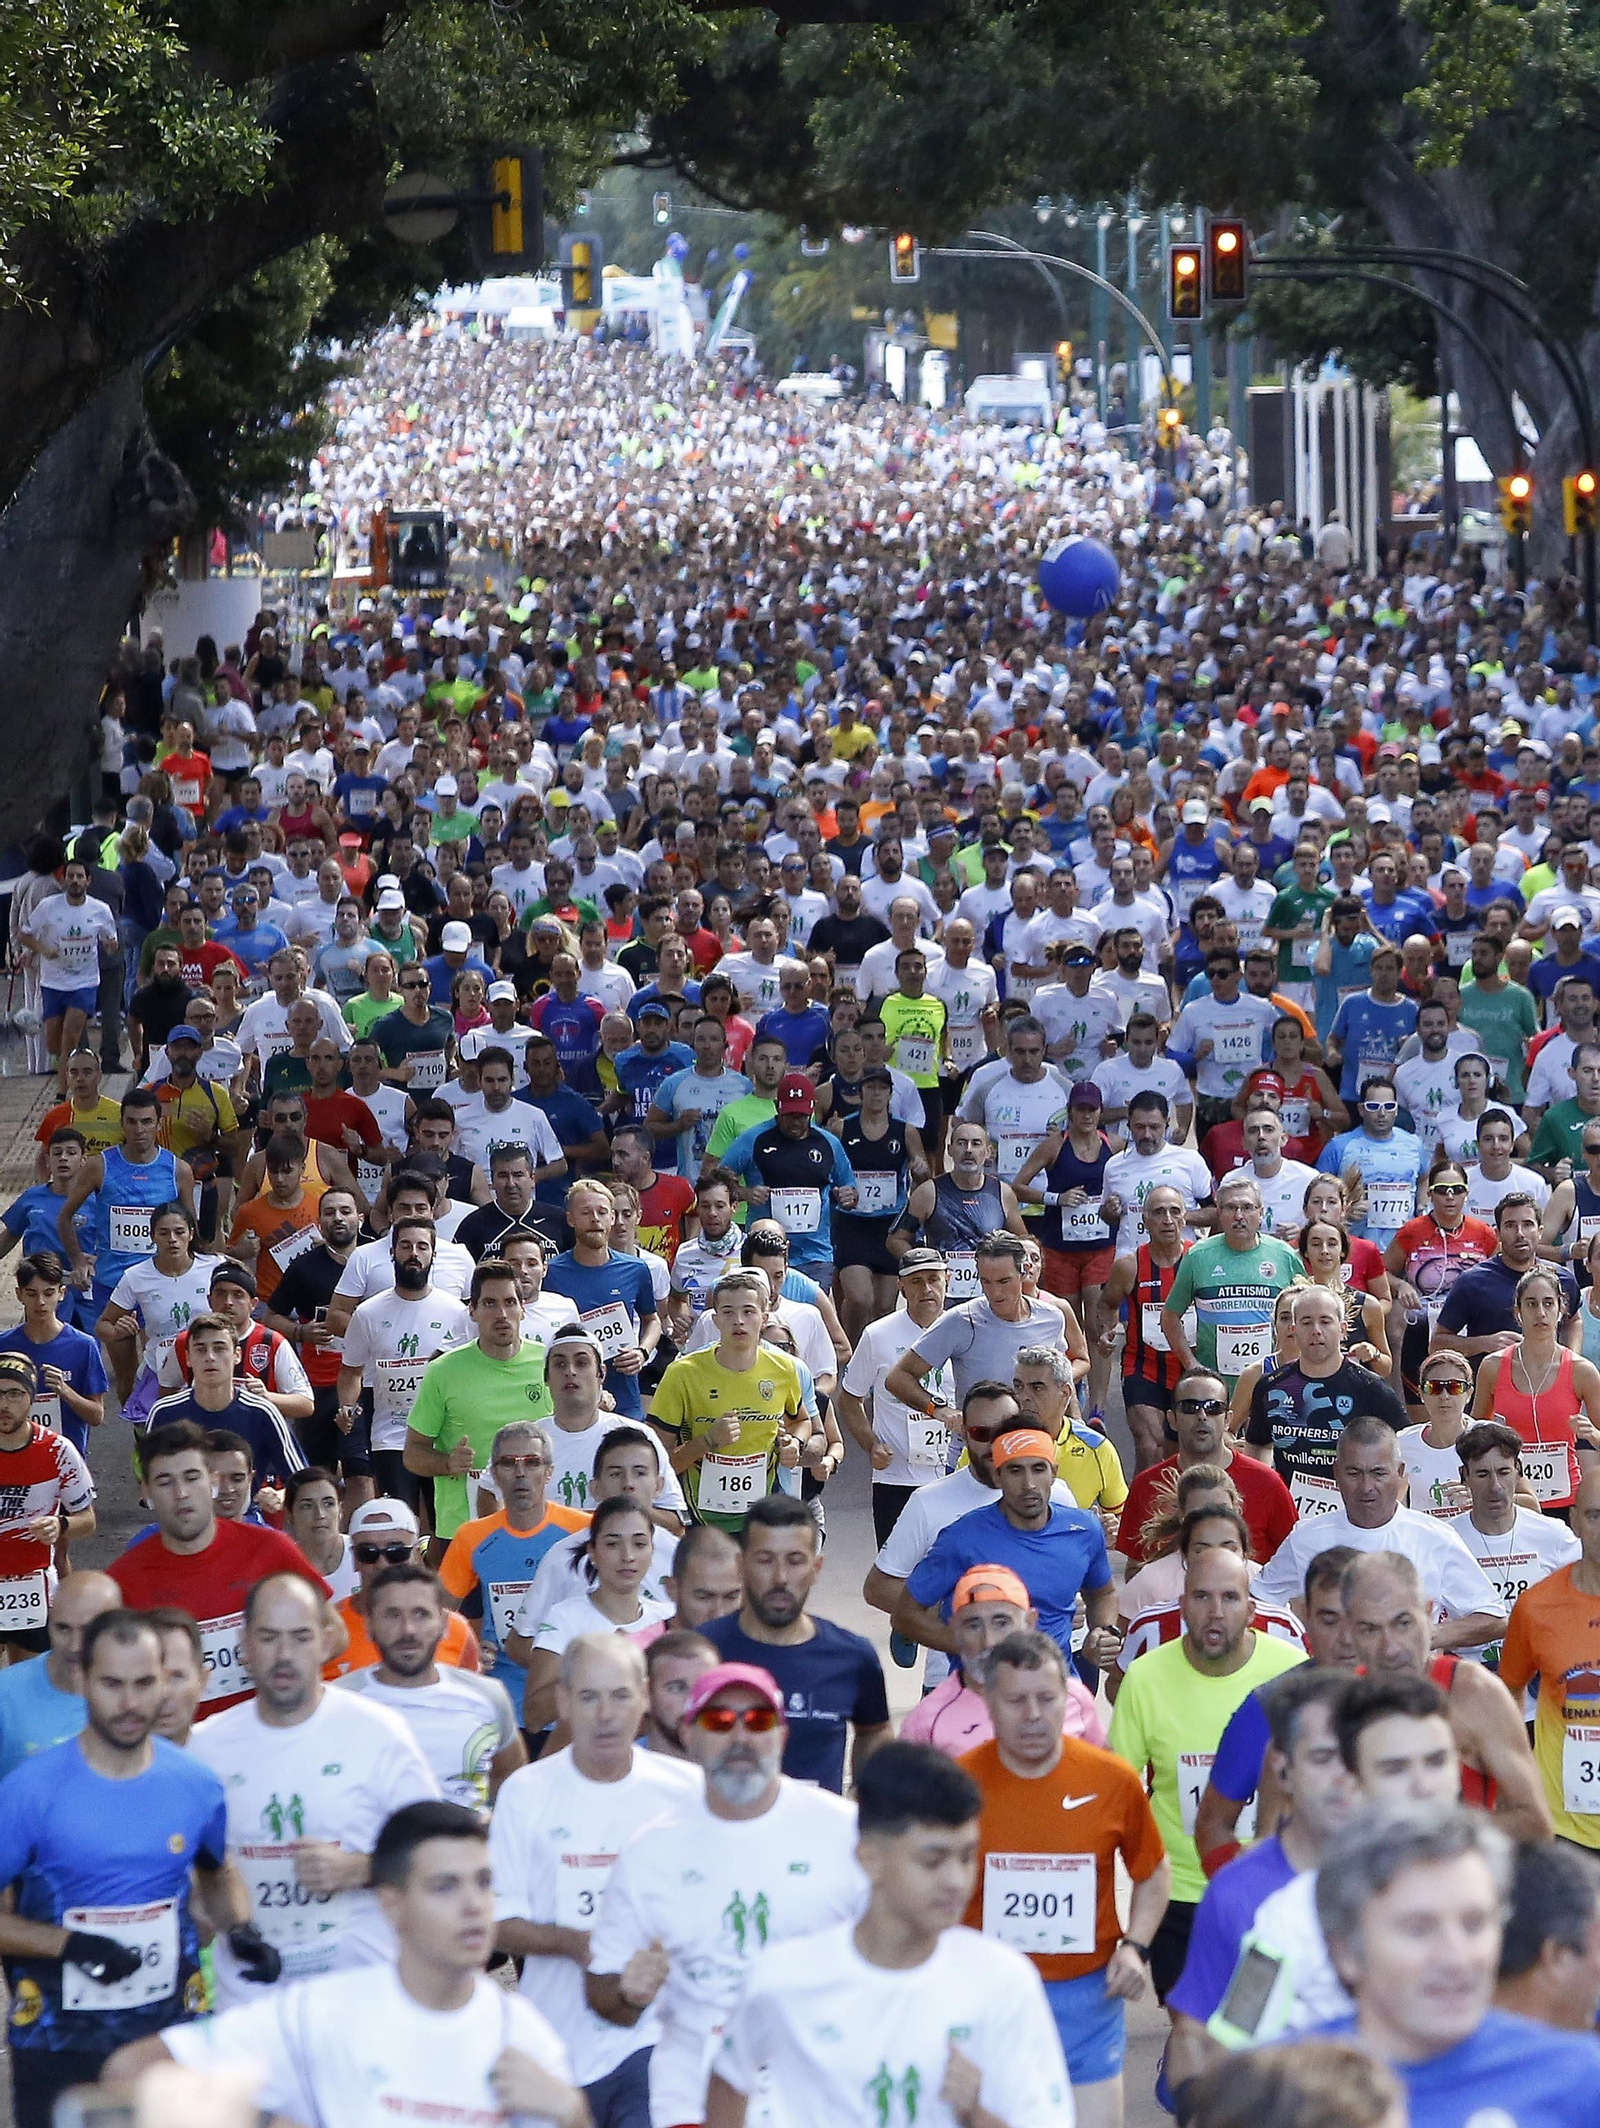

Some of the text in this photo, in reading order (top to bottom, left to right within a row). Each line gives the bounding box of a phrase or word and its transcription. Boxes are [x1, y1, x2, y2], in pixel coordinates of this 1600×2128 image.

[953, 1038, 972, 1048] 885
[1221, 1036, 1251, 1048] 1426
[908, 1048, 927, 1060] 421
[418, 1064, 444, 1076] 7109
[1015, 1146, 1030, 1158] 87
[865, 1186, 881, 1198] 72
[785, 1203, 810, 1216] 117
[1372, 1200, 1409, 1213] 17775
[1071, 1213, 1100, 1227] 6407
[115, 1223, 150, 1238] 1808
[1218, 1286, 1270, 1297] ATLETISMO
[1210, 1299, 1276, 1311] TORREMOLINO
[594, 1321, 623, 1341] 298
[1231, 1342, 1260, 1357] 426
[388, 1376, 424, 1392] 224
[1272, 1424, 1329, 1439] BROTHERS
[1287, 1451, 1338, 1466] milleniu
[718, 1474, 752, 1493] 186
[2, 1497, 26, 1508] THE
[1003, 1891, 1074, 1919] 2901
